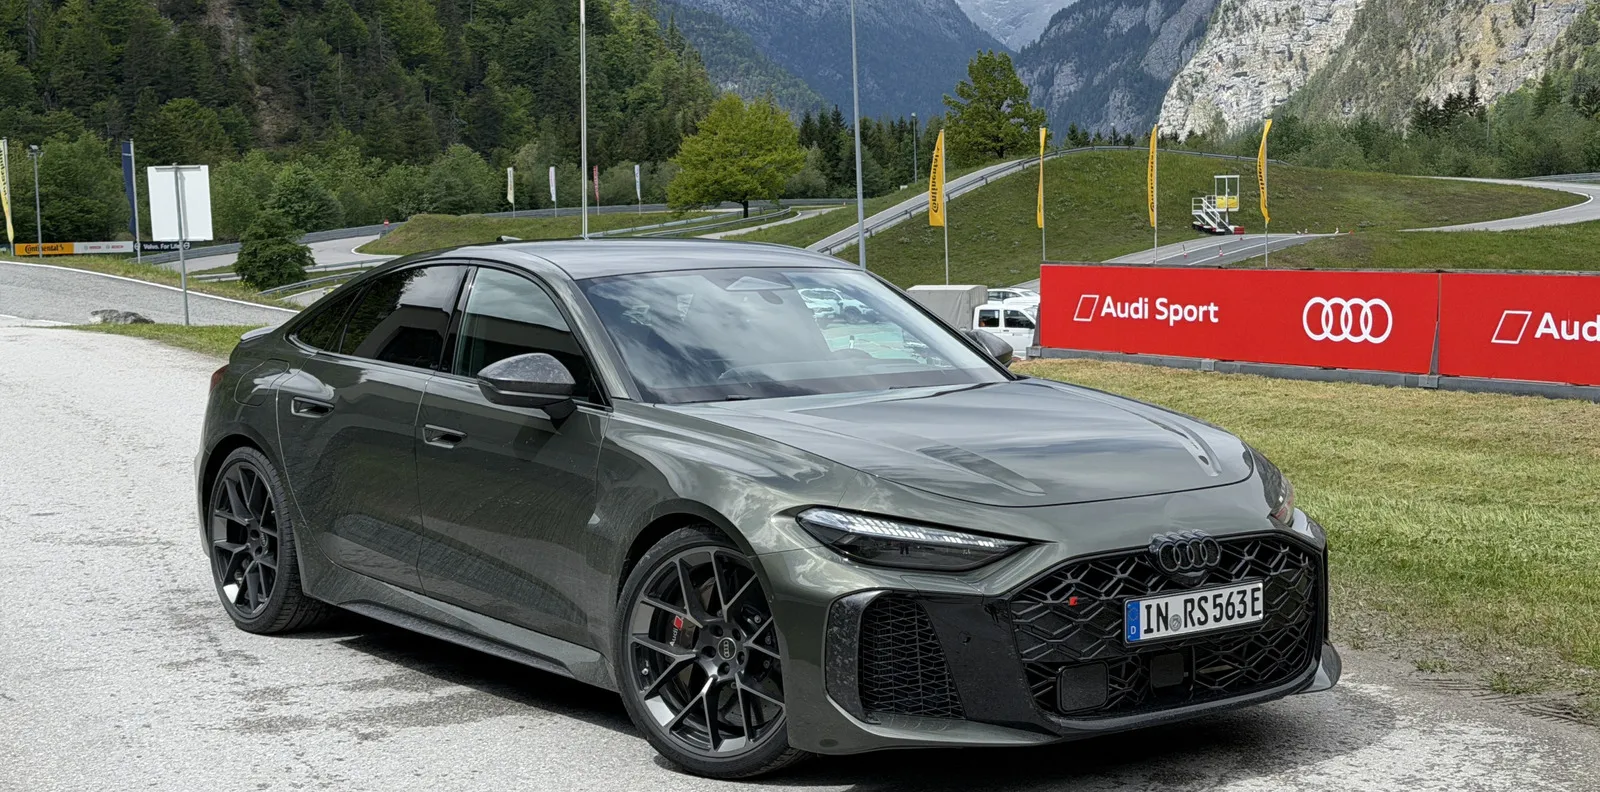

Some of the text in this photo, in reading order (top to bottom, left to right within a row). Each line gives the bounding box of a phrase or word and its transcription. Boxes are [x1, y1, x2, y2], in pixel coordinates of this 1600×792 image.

[1101, 296, 1219, 327] Audi Sport
[1144, 602, 1168, 634] IN
[1183, 596, 1209, 628] RS
[670, 628, 678, 646] Audi
[1130, 626, 1136, 634] D
